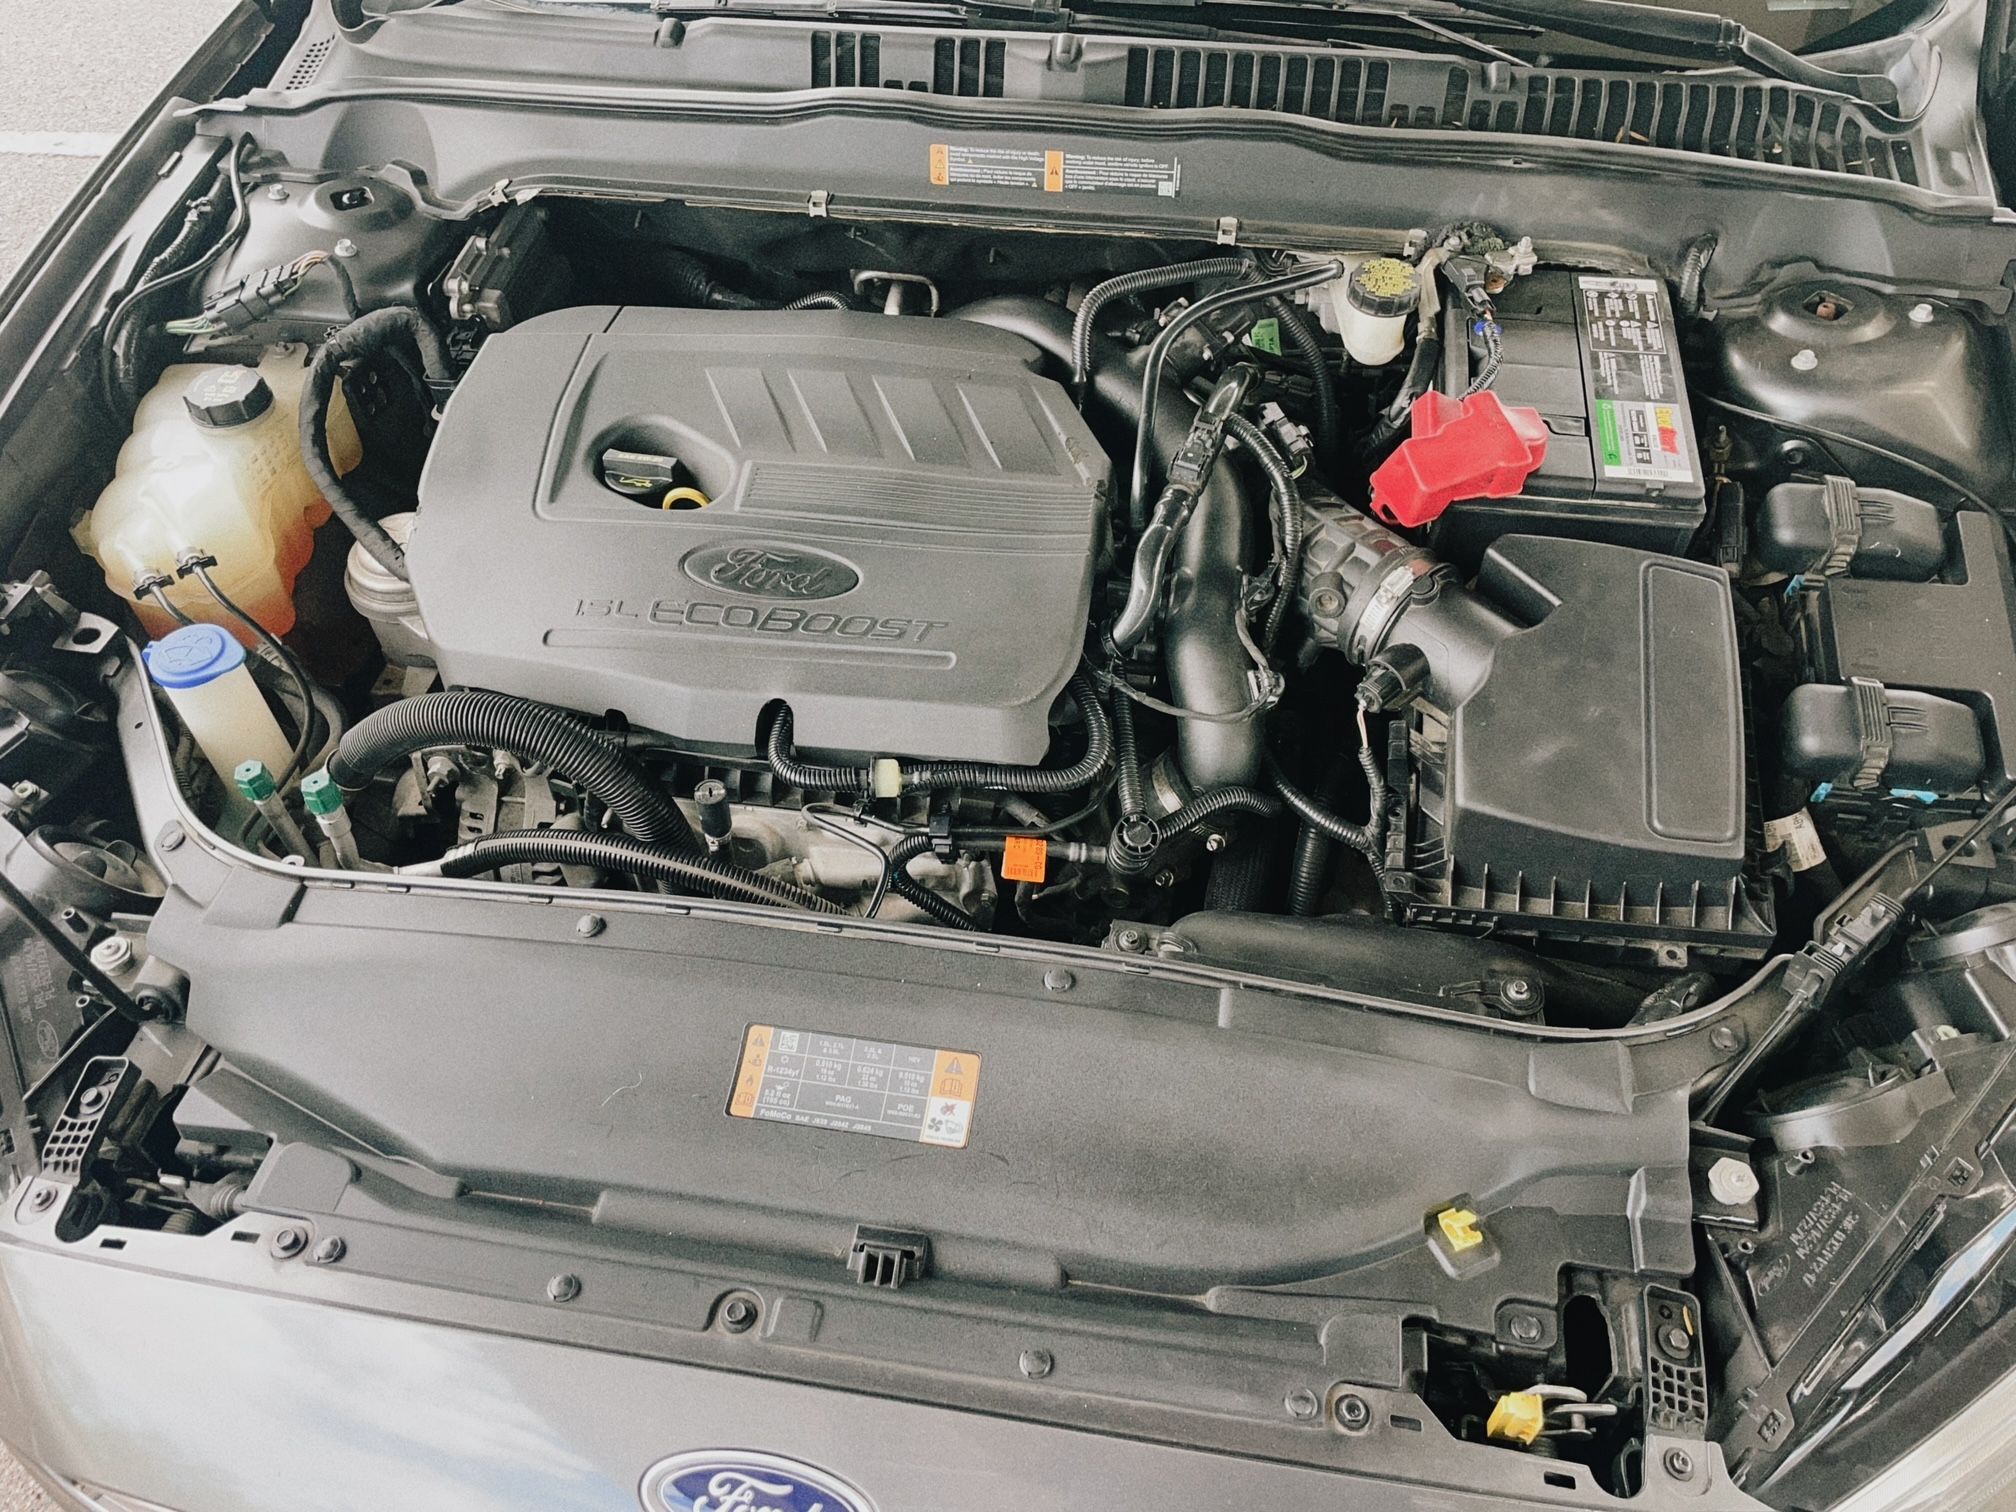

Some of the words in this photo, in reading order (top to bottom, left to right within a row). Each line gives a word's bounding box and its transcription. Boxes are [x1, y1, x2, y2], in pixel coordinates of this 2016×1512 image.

[711, 545, 828, 595] Ford
[767, 1064, 801, 1078] R-1234yf
[760, 1108, 792, 1121] FoMoCo
